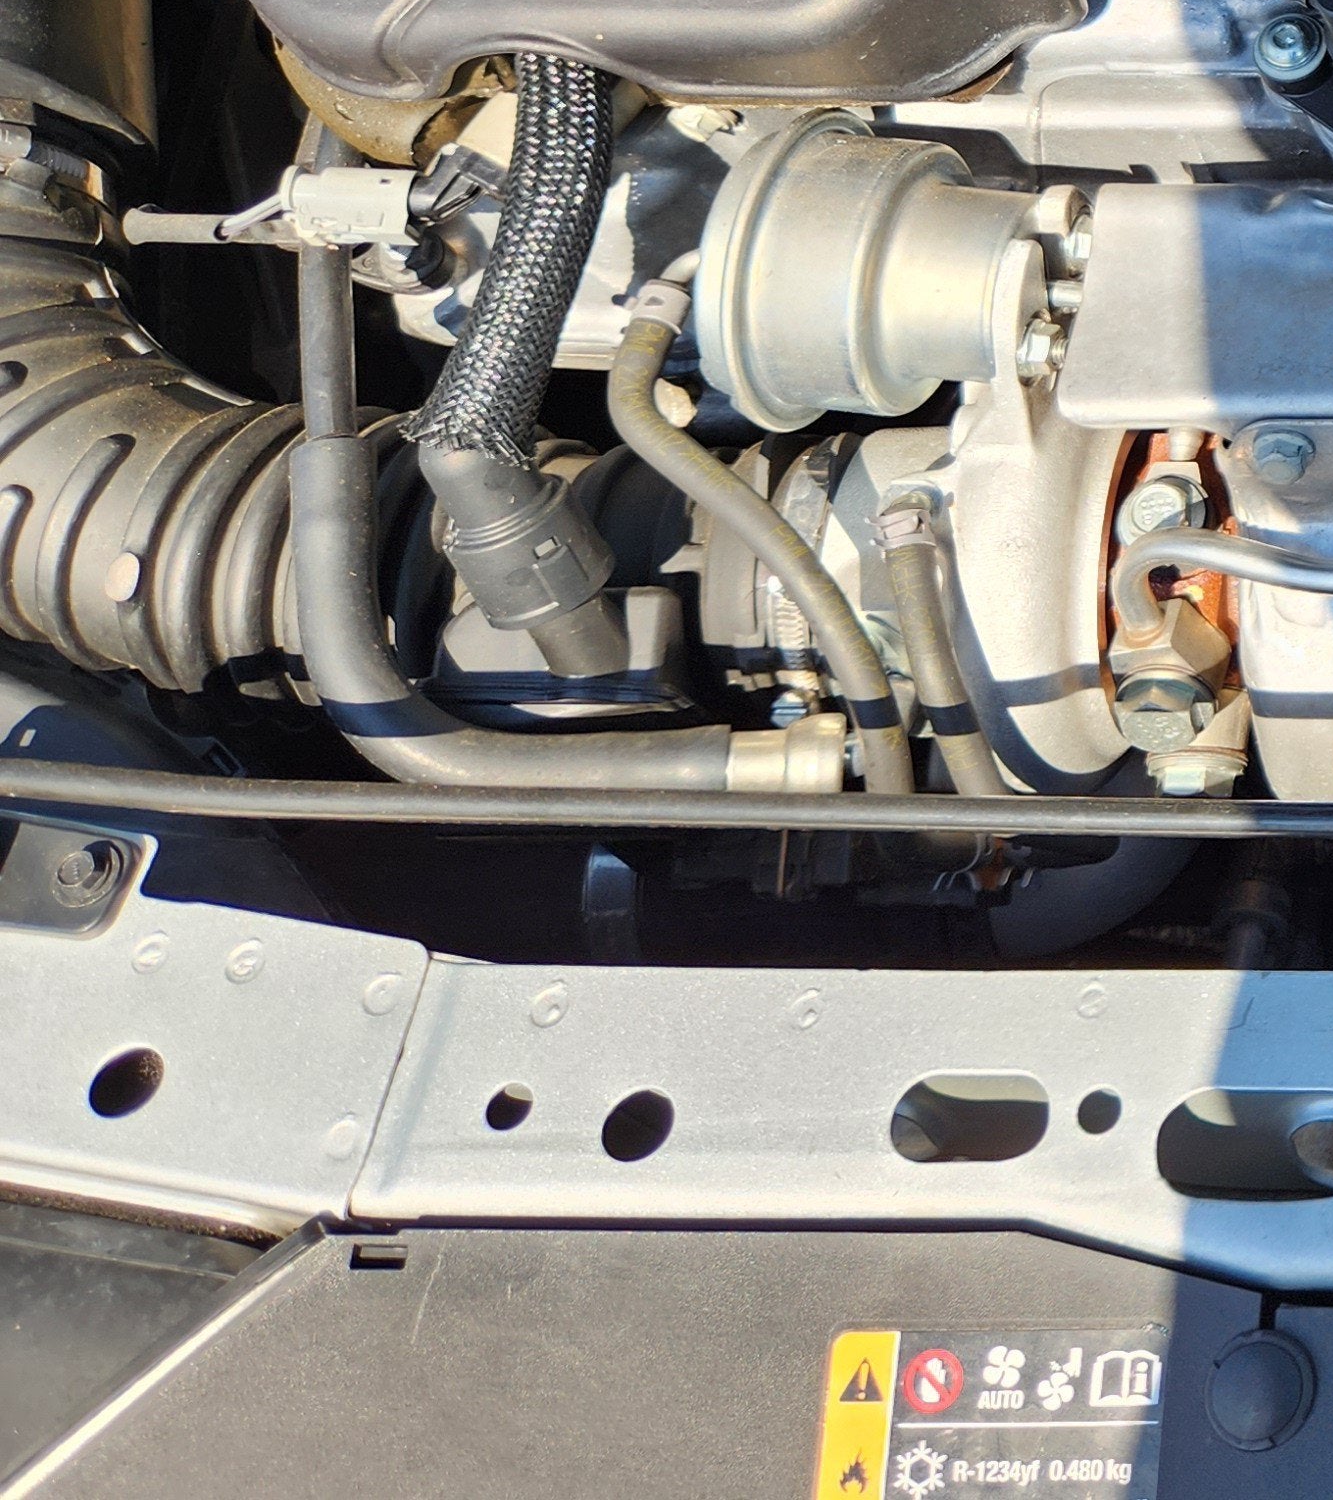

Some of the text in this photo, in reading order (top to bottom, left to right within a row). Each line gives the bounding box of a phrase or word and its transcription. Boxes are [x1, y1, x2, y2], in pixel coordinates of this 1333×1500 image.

[977, 1389, 1025, 1410] AUTO
[952, 1458, 1132, 1487] R-1234yf 0.480 kg
